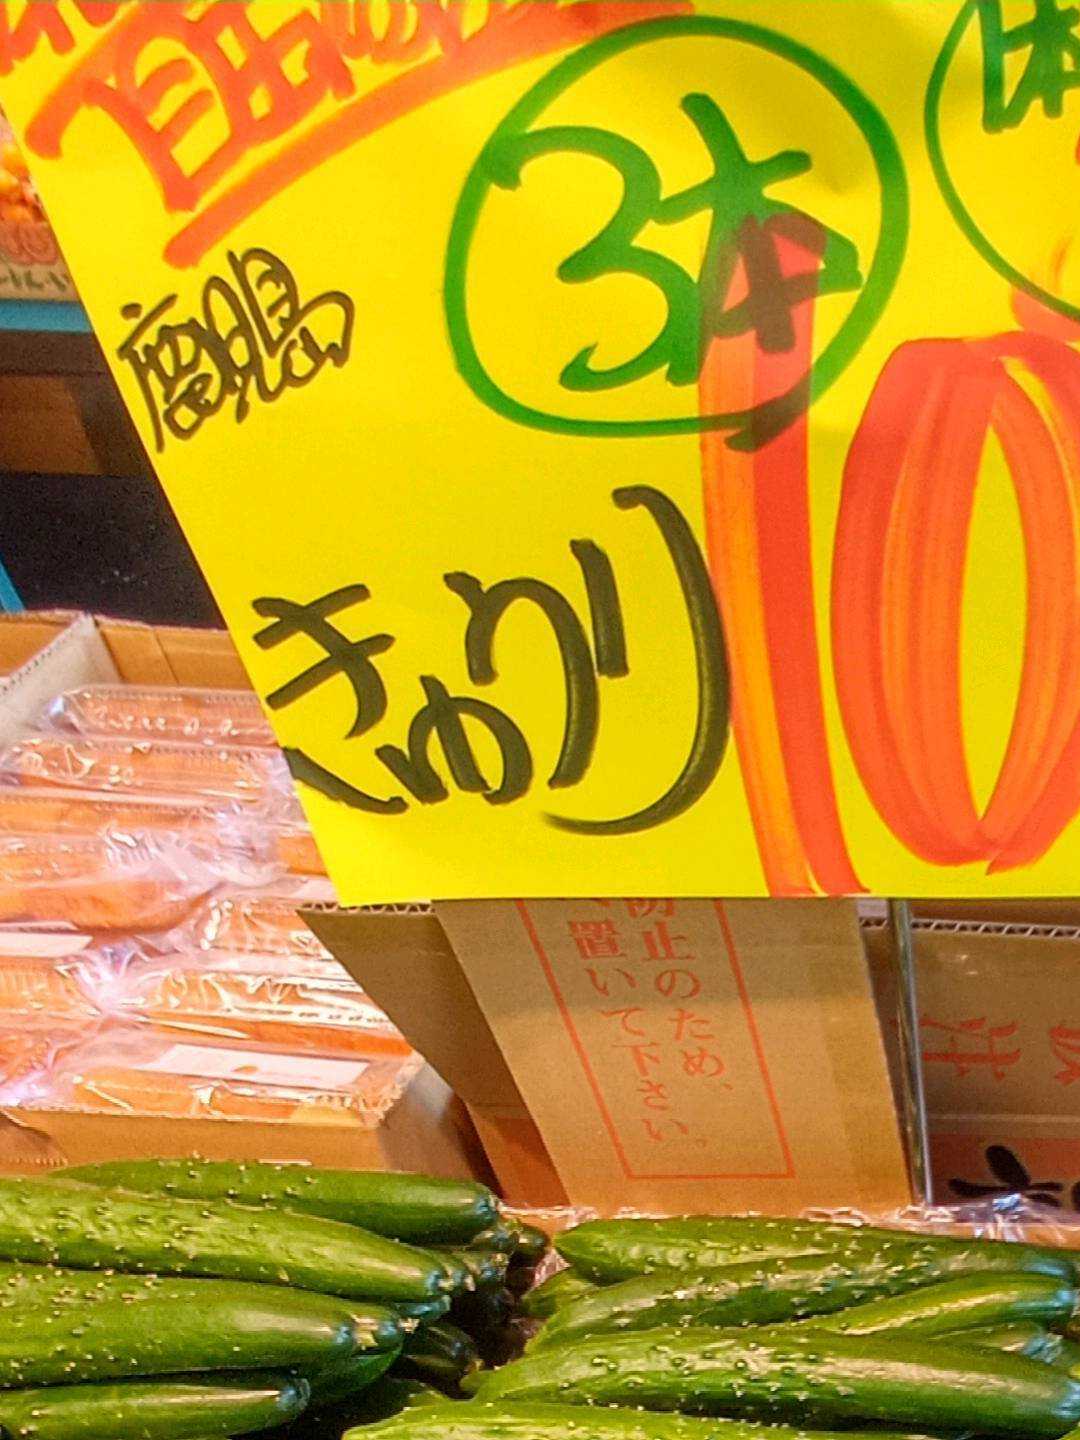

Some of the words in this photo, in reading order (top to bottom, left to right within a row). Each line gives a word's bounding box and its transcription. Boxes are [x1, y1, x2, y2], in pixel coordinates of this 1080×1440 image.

[485, 92, 862, 392] 3本
[252, 485, 732, 836] きゅうり
